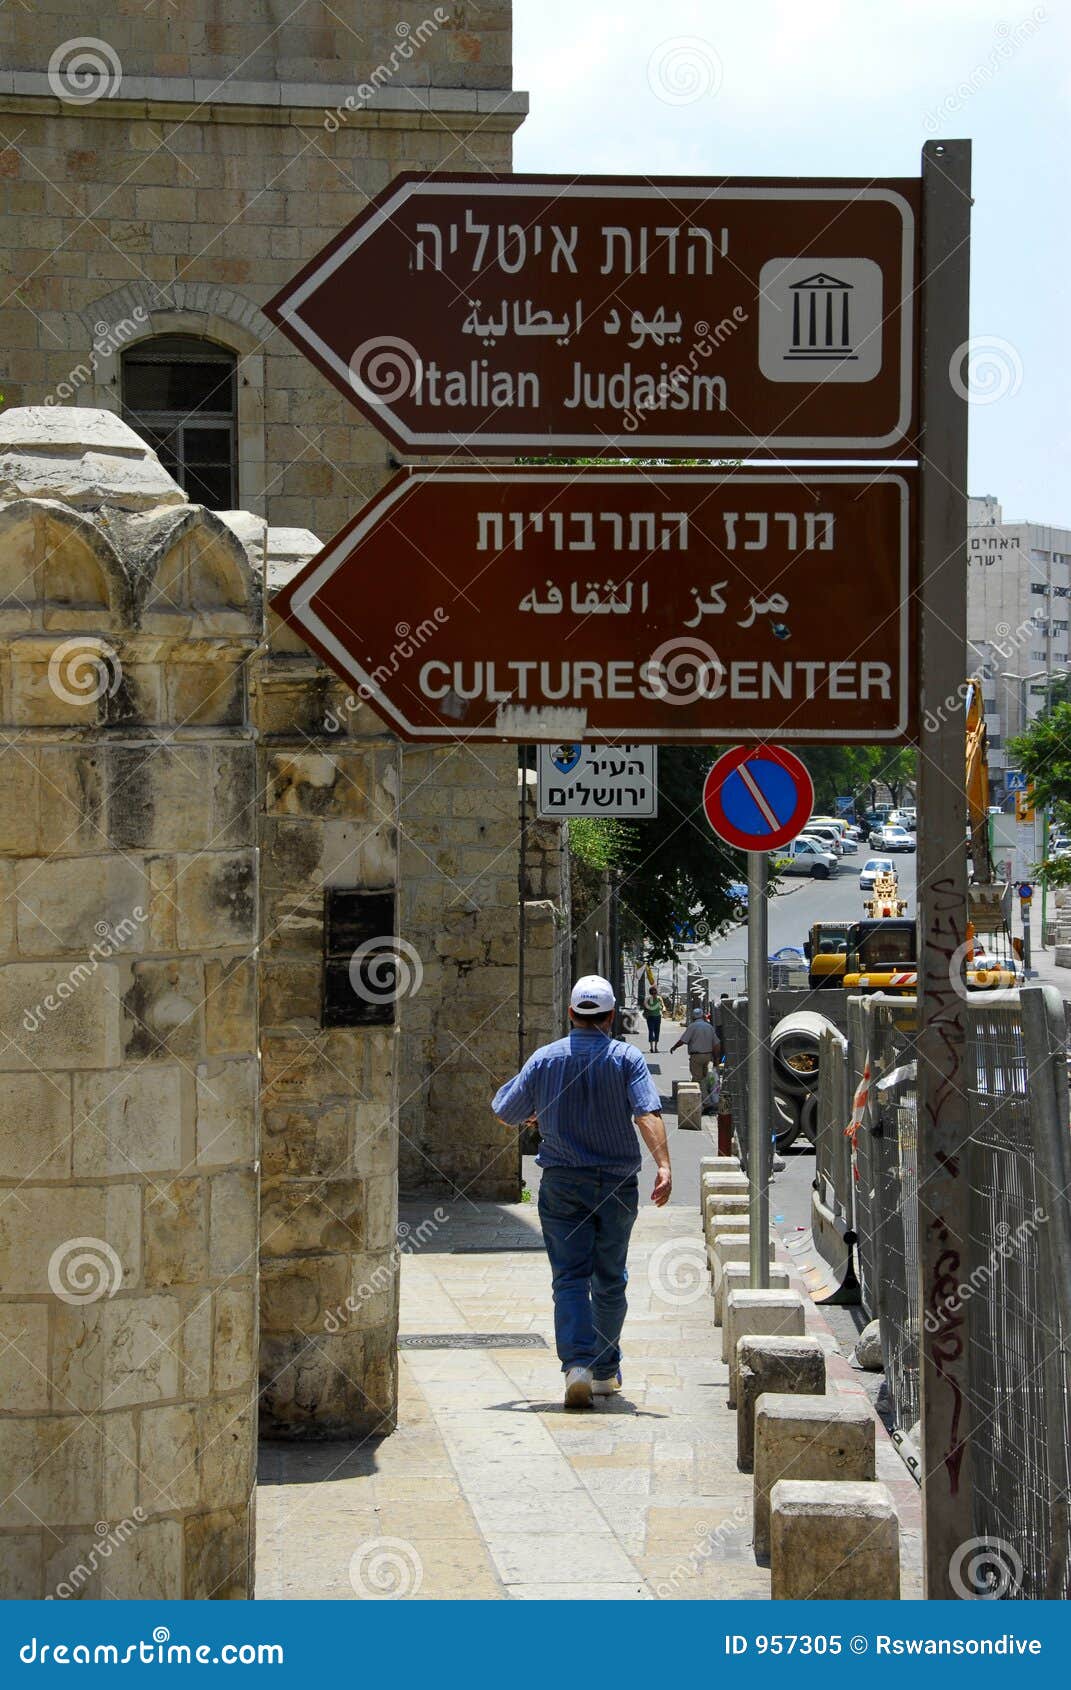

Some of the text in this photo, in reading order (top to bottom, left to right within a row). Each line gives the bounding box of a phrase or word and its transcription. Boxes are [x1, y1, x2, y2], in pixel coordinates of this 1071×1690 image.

[416, 210, 728, 275] יהדות איטליה
[461, 299, 682, 349] يهود ايطالية
[415, 359, 728, 411] Italian Judaism
[476, 512, 835, 551] מרכז התרבויות
[971, 537, 1020, 550] האחים
[419, 660, 892, 702] CULTURES CENTER
[585, 760, 645, 778] העיר
[548, 782, 647, 807] ירושלים
